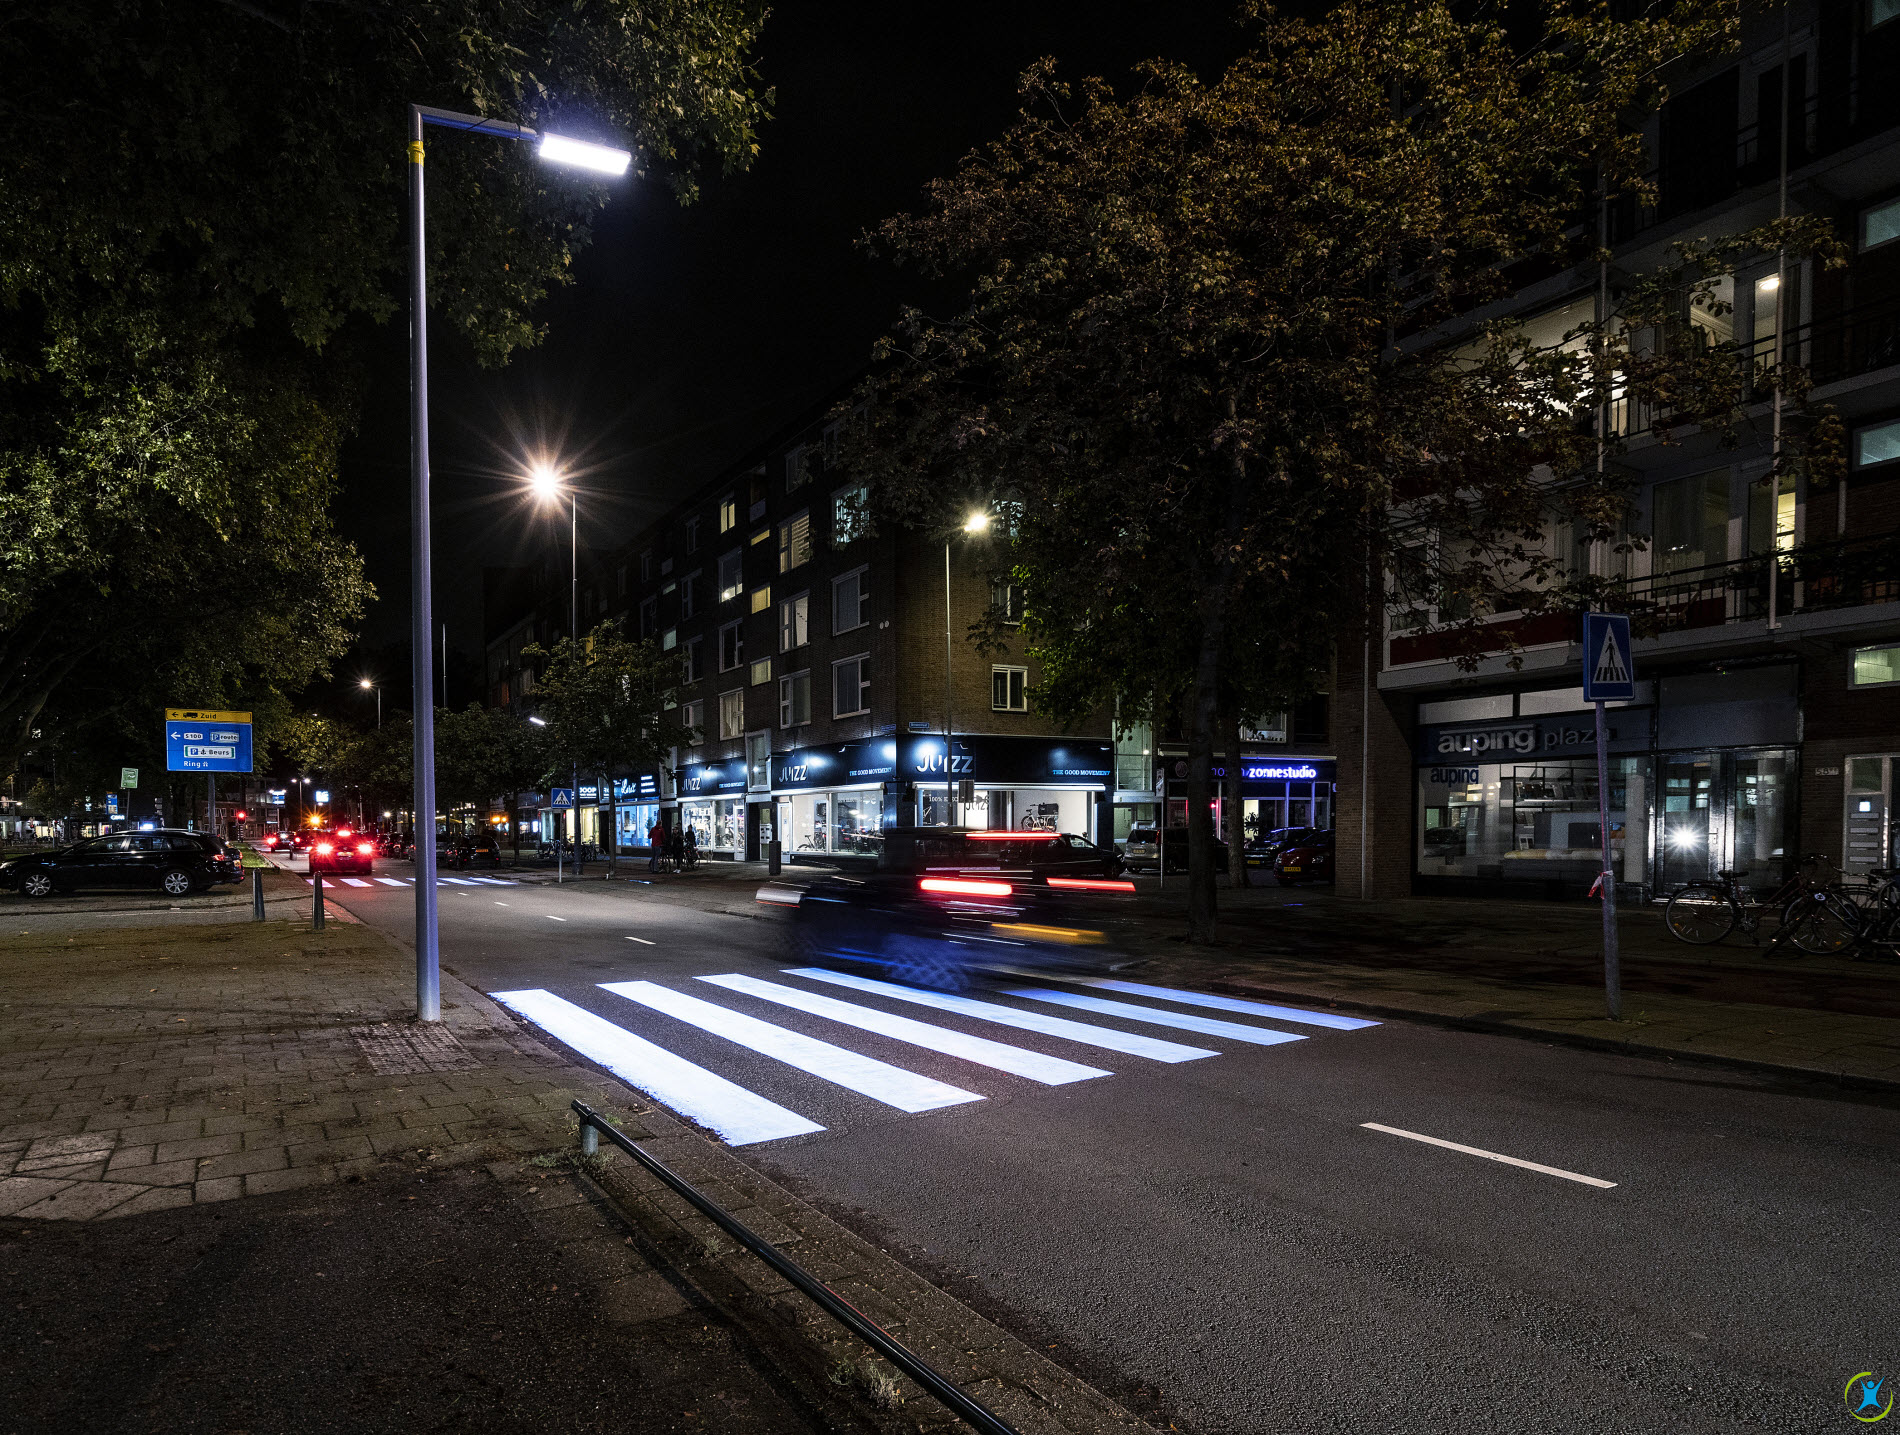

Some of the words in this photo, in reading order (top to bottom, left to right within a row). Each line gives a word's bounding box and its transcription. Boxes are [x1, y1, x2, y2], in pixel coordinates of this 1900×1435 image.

[1437, 728, 1536, 756] auping
[183, 760, 201, 768] Ring
[915, 754, 974, 773] JUIZZ
[1248, 764, 1317, 779] zonnestudio
[778, 765, 808, 782] JUIZZ
